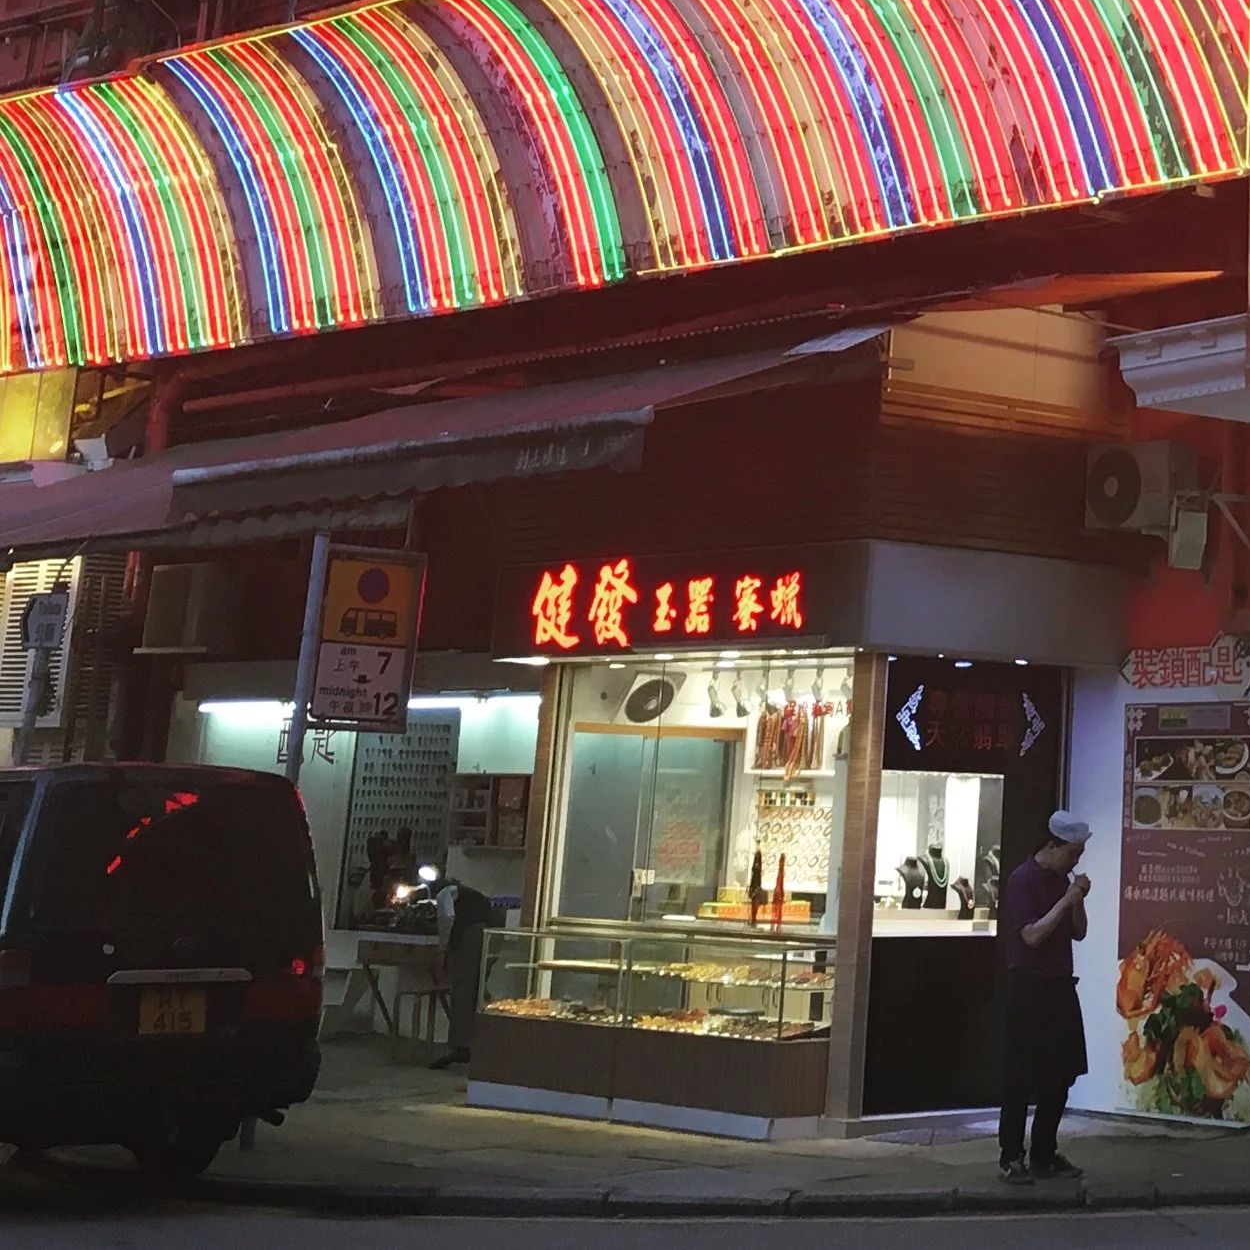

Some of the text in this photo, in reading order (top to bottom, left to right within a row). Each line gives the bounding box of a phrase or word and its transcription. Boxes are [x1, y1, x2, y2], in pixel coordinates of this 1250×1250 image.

[340, 646, 357, 656] am
[333, 658, 360, 672] 上午
[377, 651, 393, 675] 7
[1132, 644, 1244, 690] 裝鎖配匙
[318, 684, 368, 700] midnight
[373, 691, 400, 717] 12
